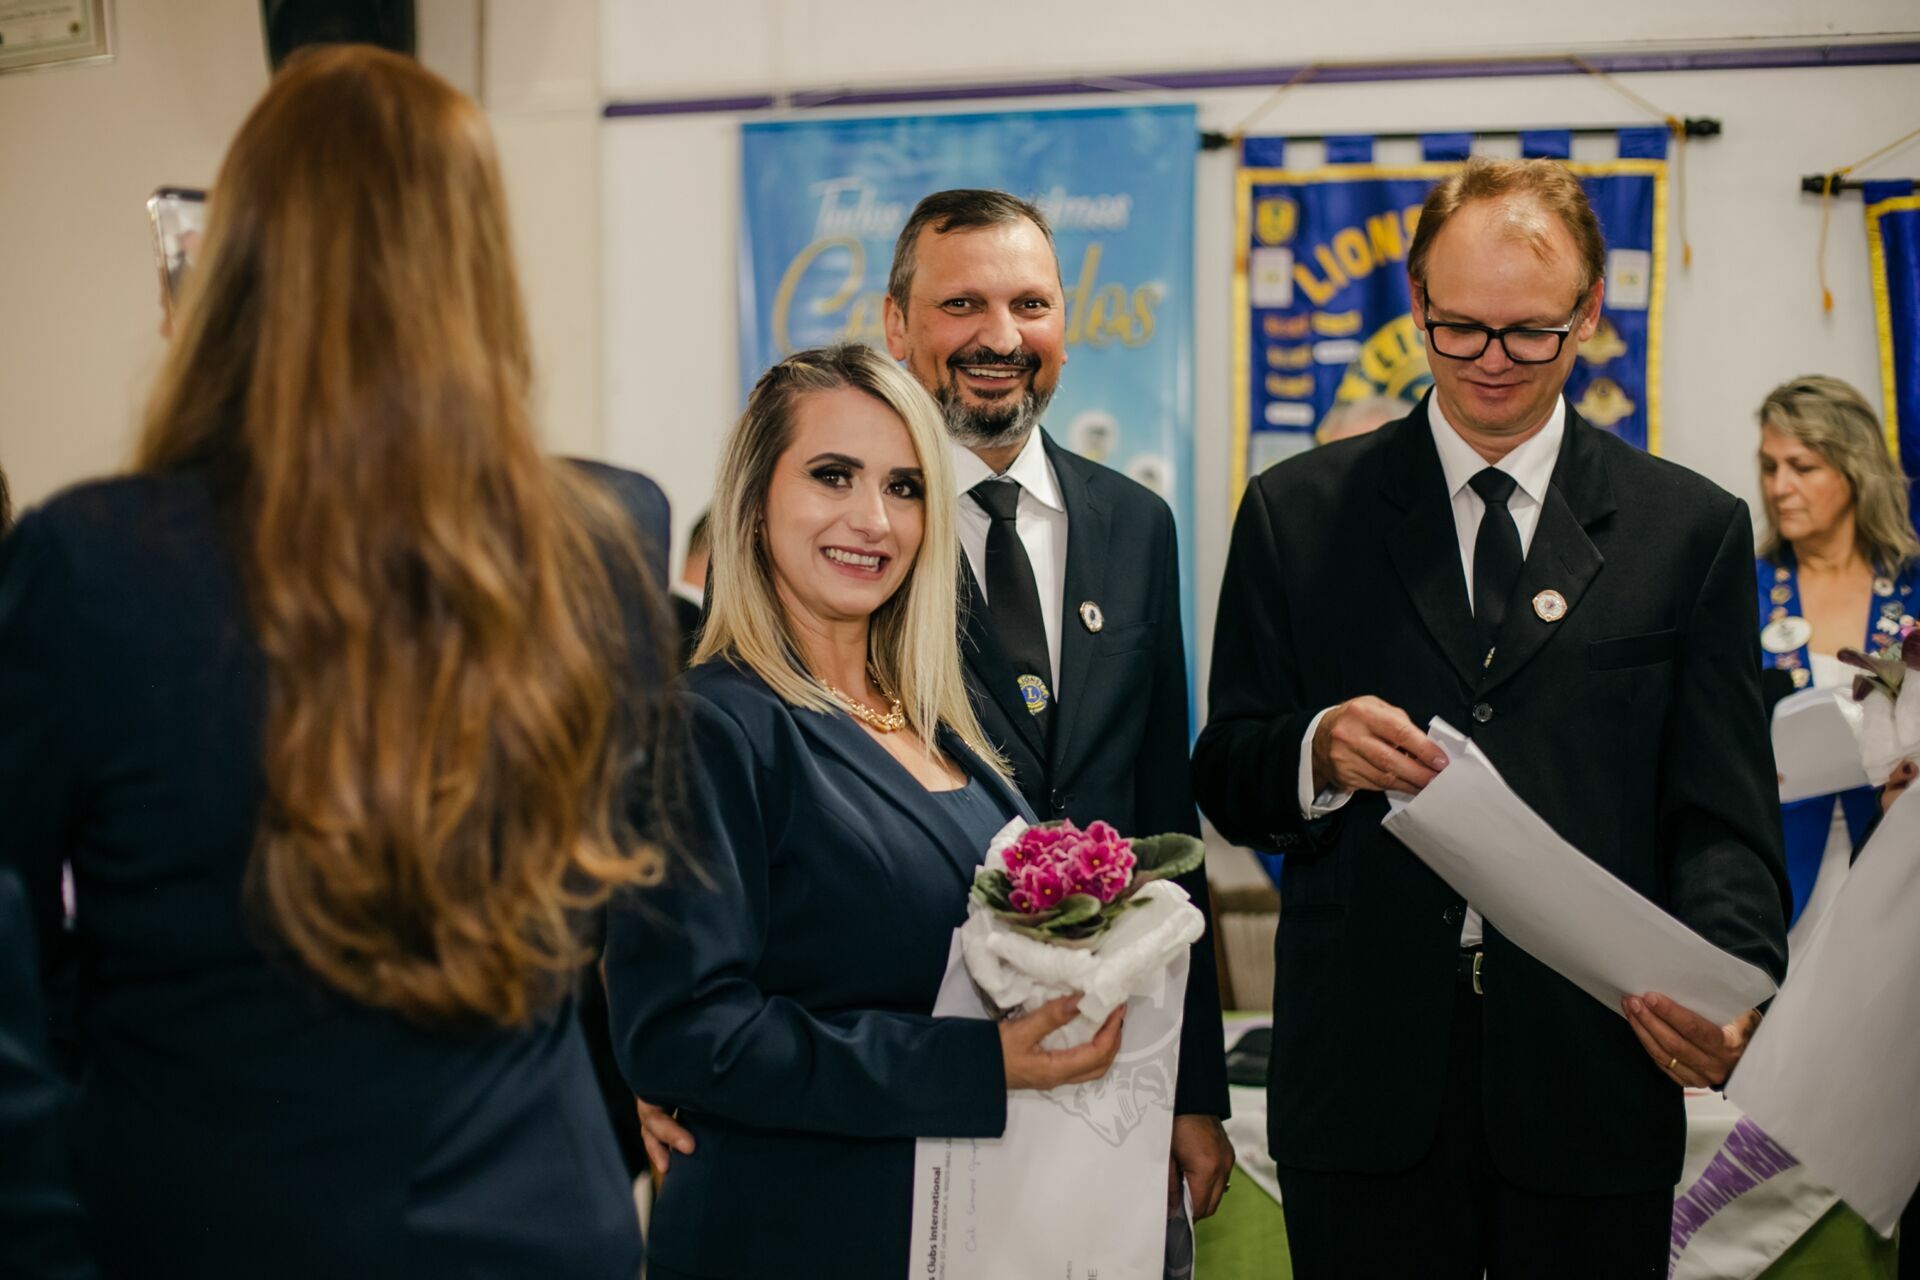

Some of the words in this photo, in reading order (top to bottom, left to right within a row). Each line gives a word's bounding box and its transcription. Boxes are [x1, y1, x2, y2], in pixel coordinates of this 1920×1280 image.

[1026, 687, 1037, 699] L
[929, 1166, 941, 1241] International
[927, 1244, 937, 1273] Clubs
